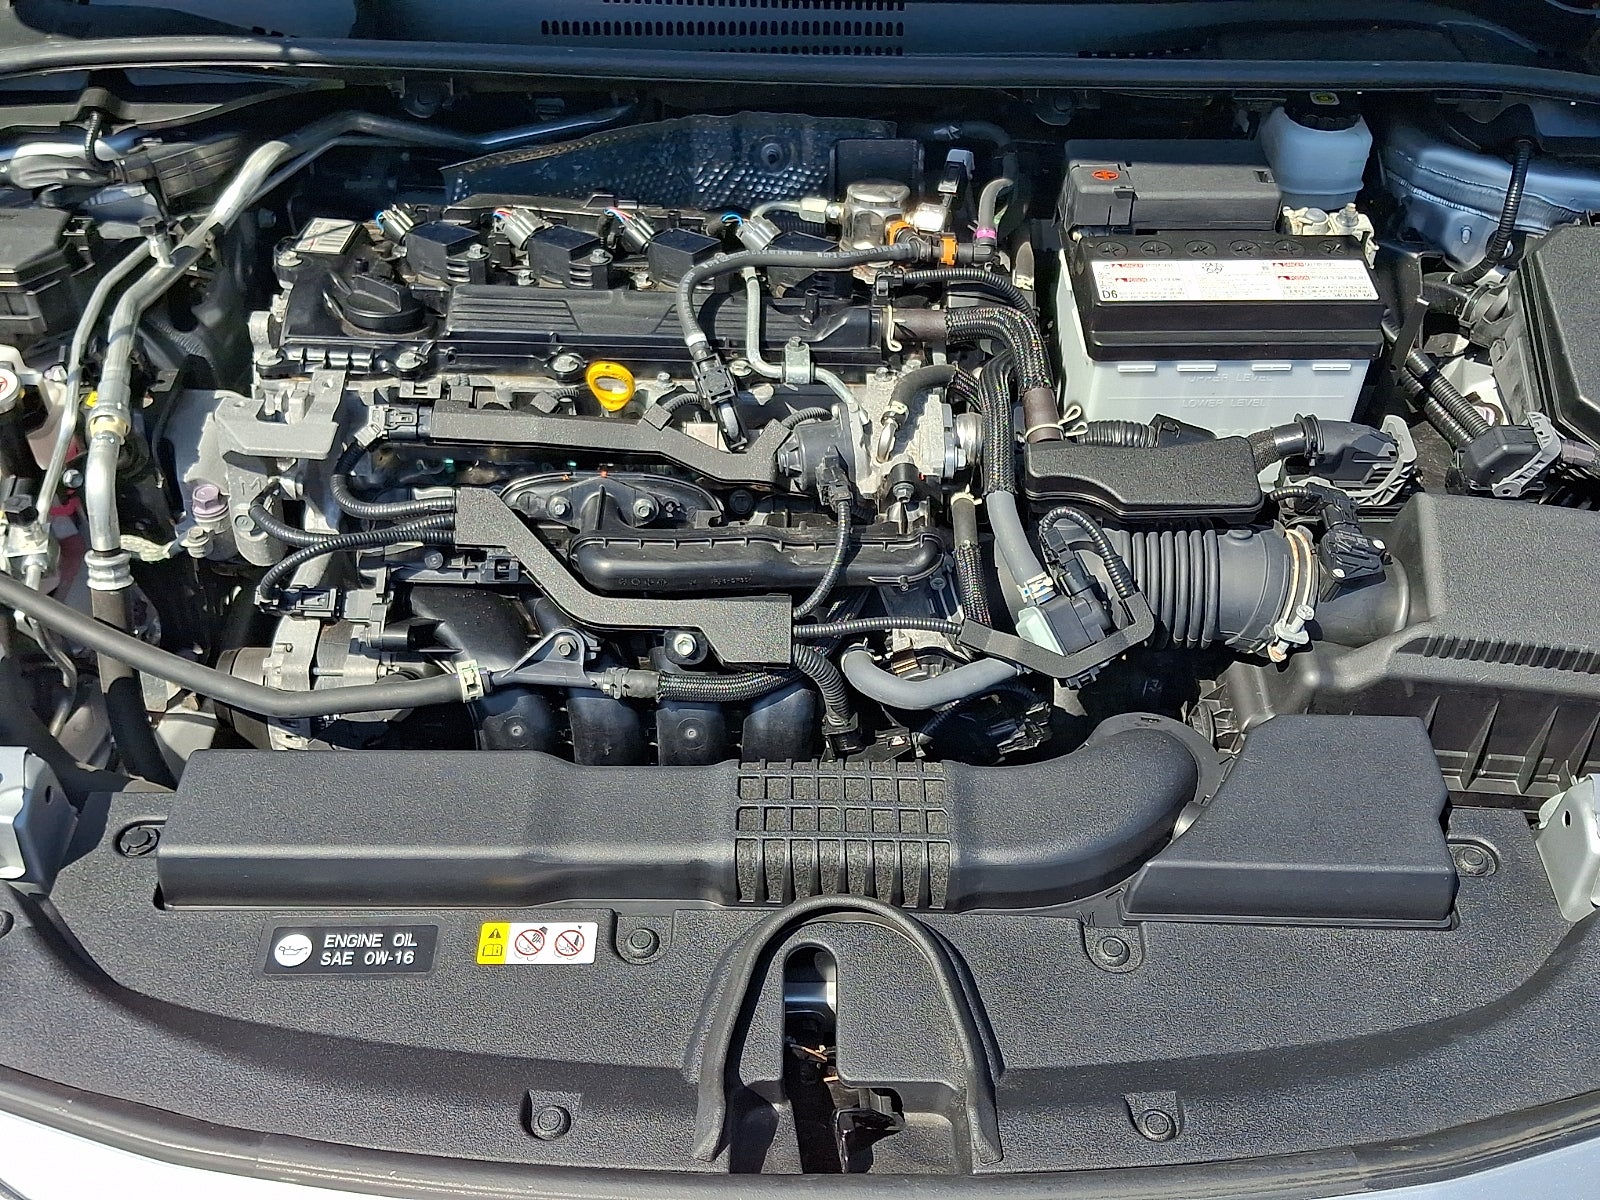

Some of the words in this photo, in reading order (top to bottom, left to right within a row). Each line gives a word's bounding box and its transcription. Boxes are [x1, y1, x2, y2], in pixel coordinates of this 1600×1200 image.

[1101, 289, 1118, 299] D6
[1182, 399, 1223, 409] LOWER
[1230, 398, 1266, 408] LEVEL
[323, 933, 384, 948] ENGINE
[392, 933, 418, 947] OIL
[320, 951, 355, 966] SAE
